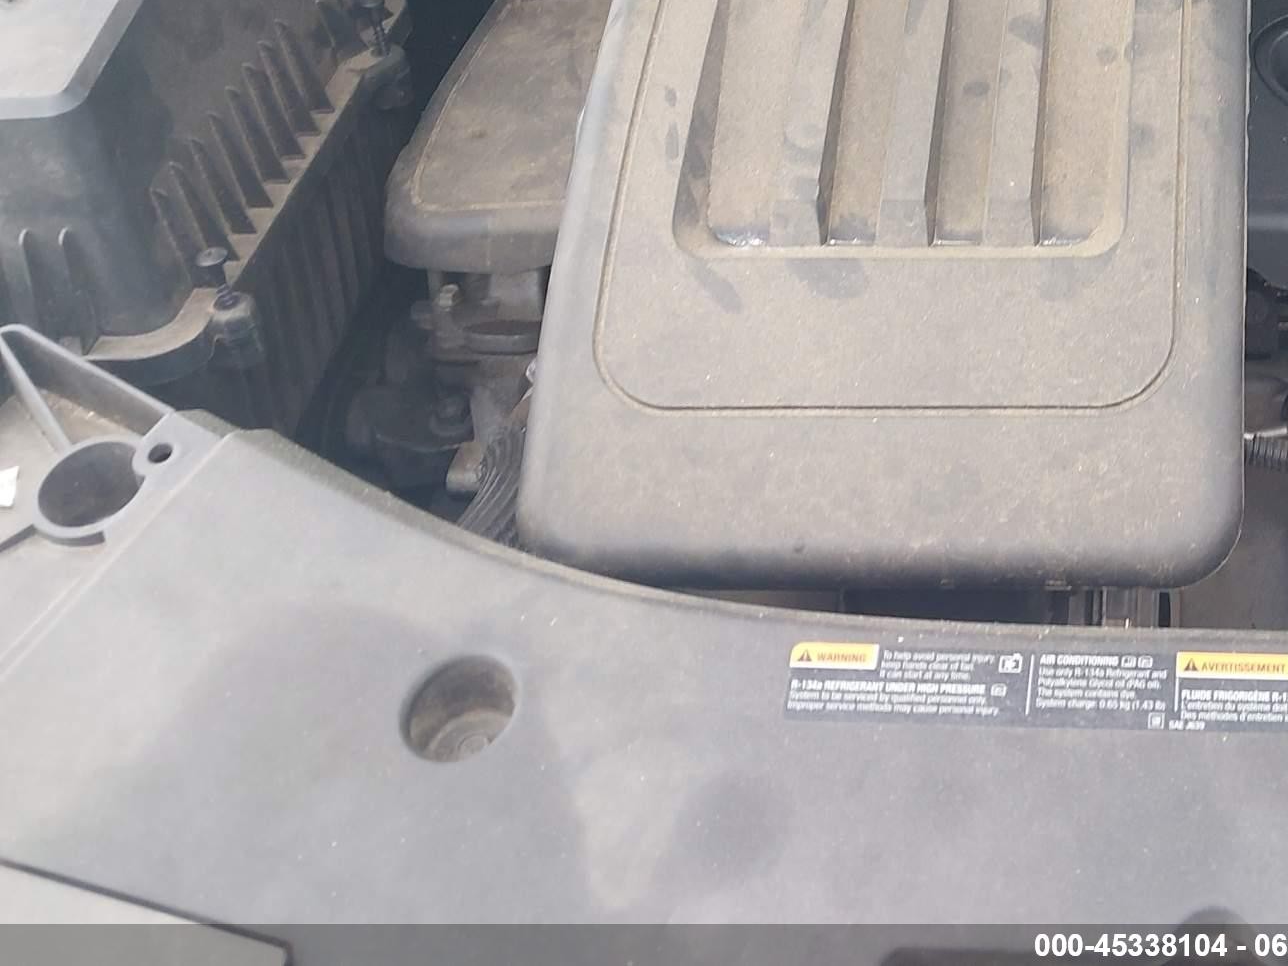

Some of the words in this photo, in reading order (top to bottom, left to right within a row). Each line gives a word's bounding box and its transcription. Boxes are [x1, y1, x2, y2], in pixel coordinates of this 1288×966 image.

[817, 653, 867, 663] WARNING
[1040, 654, 1056, 666] AIR
[1057, 655, 1119, 667] CONDITIONING
[1201, 662, 1286, 674] AVERTISSEMENT
[791, 679, 823, 691] R-134a
[824, 680, 885, 693] REFRIGERANT
[885, 682, 917, 694] UNDER
[917, 682, 939, 694] HIGH
[940, 683, 986, 695] PRESSURE
[1181, 689, 1212, 701] FLUIDE
